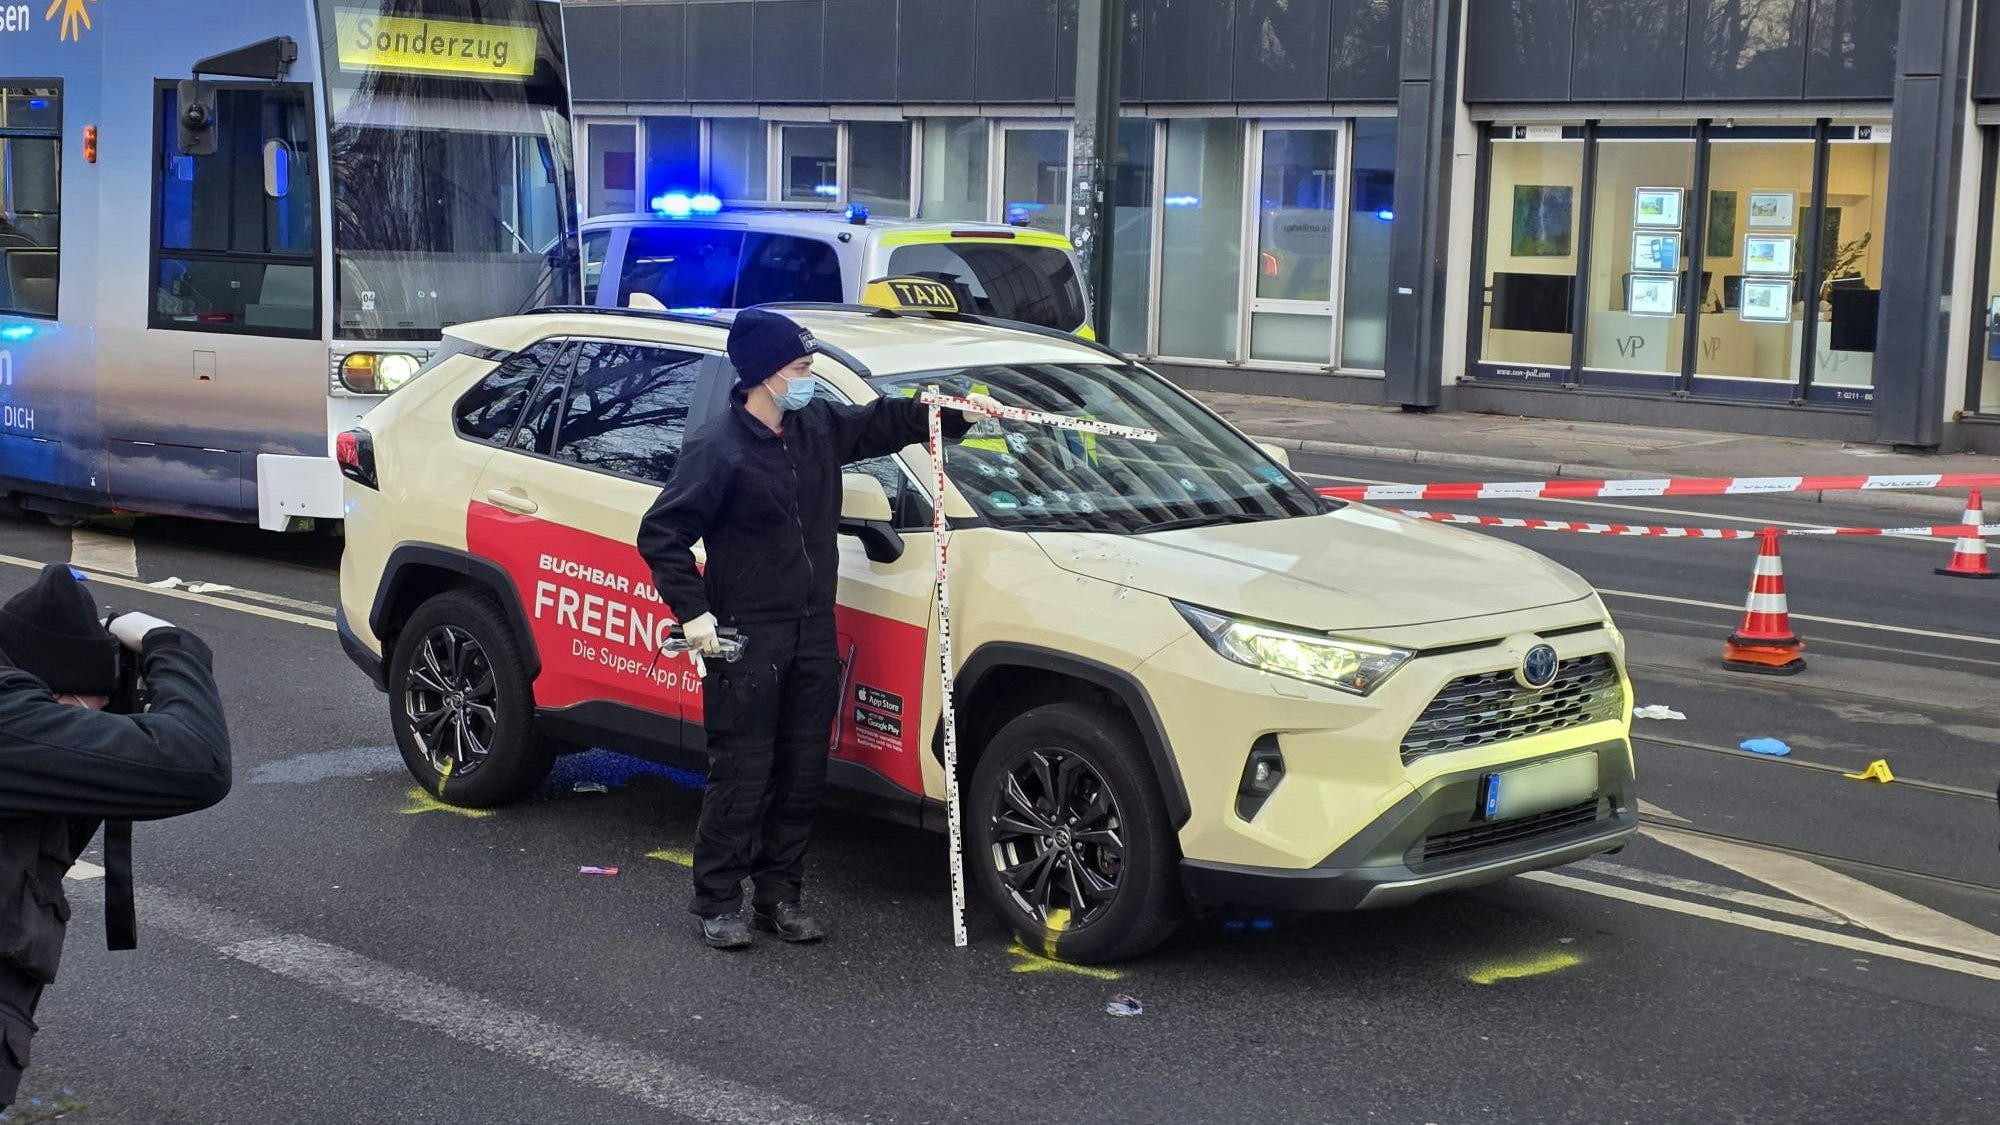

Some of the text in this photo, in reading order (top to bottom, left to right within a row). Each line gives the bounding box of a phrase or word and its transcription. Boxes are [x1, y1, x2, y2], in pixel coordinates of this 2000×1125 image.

[356, 18, 508, 67] Sonderzug
[895, 284, 950, 305] TAXI
[1616, 336, 1645, 358] VP
[4, 405, 34, 430] DICH
[539, 554, 629, 593] BUCHBAR
[572, 638, 702, 694] Die Super-App für
[869, 695, 899, 712] App Store
[867, 717, 899, 736] Google Play
